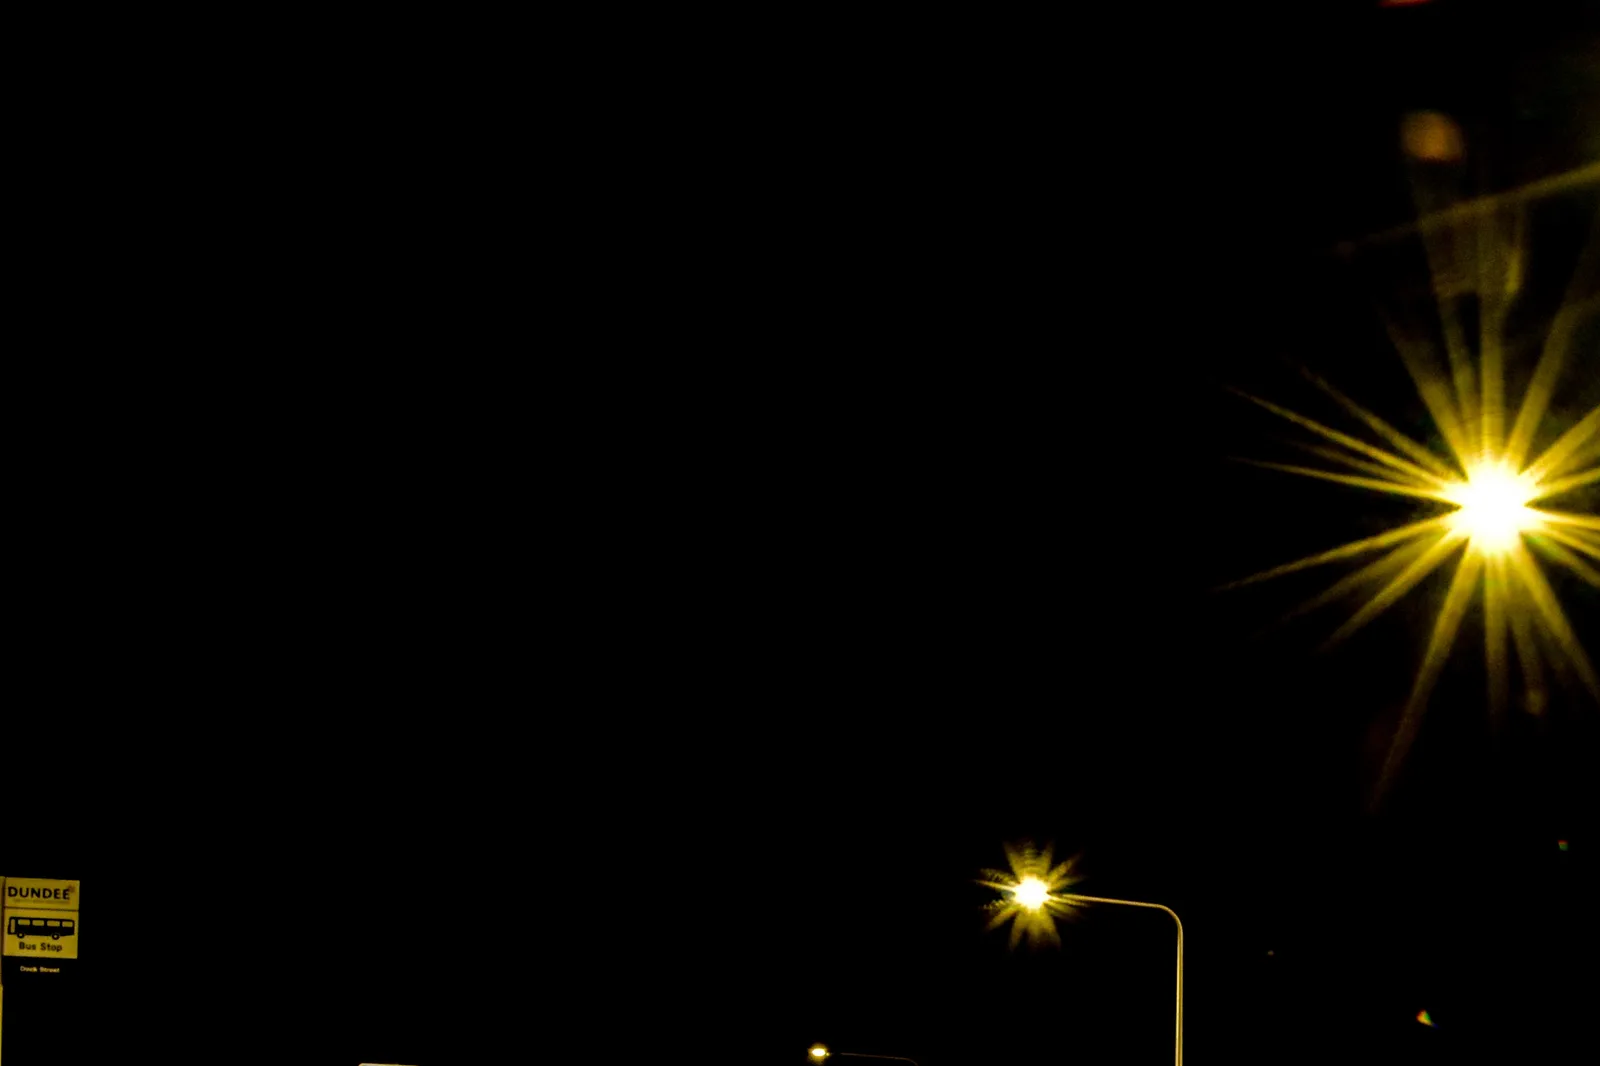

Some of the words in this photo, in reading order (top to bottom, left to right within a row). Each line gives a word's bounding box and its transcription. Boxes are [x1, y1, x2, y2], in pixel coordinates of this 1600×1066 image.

[8, 886, 70, 900] DUNDEE
[19, 942, 36, 951] Bus
[40, 942, 63, 952] Stop
